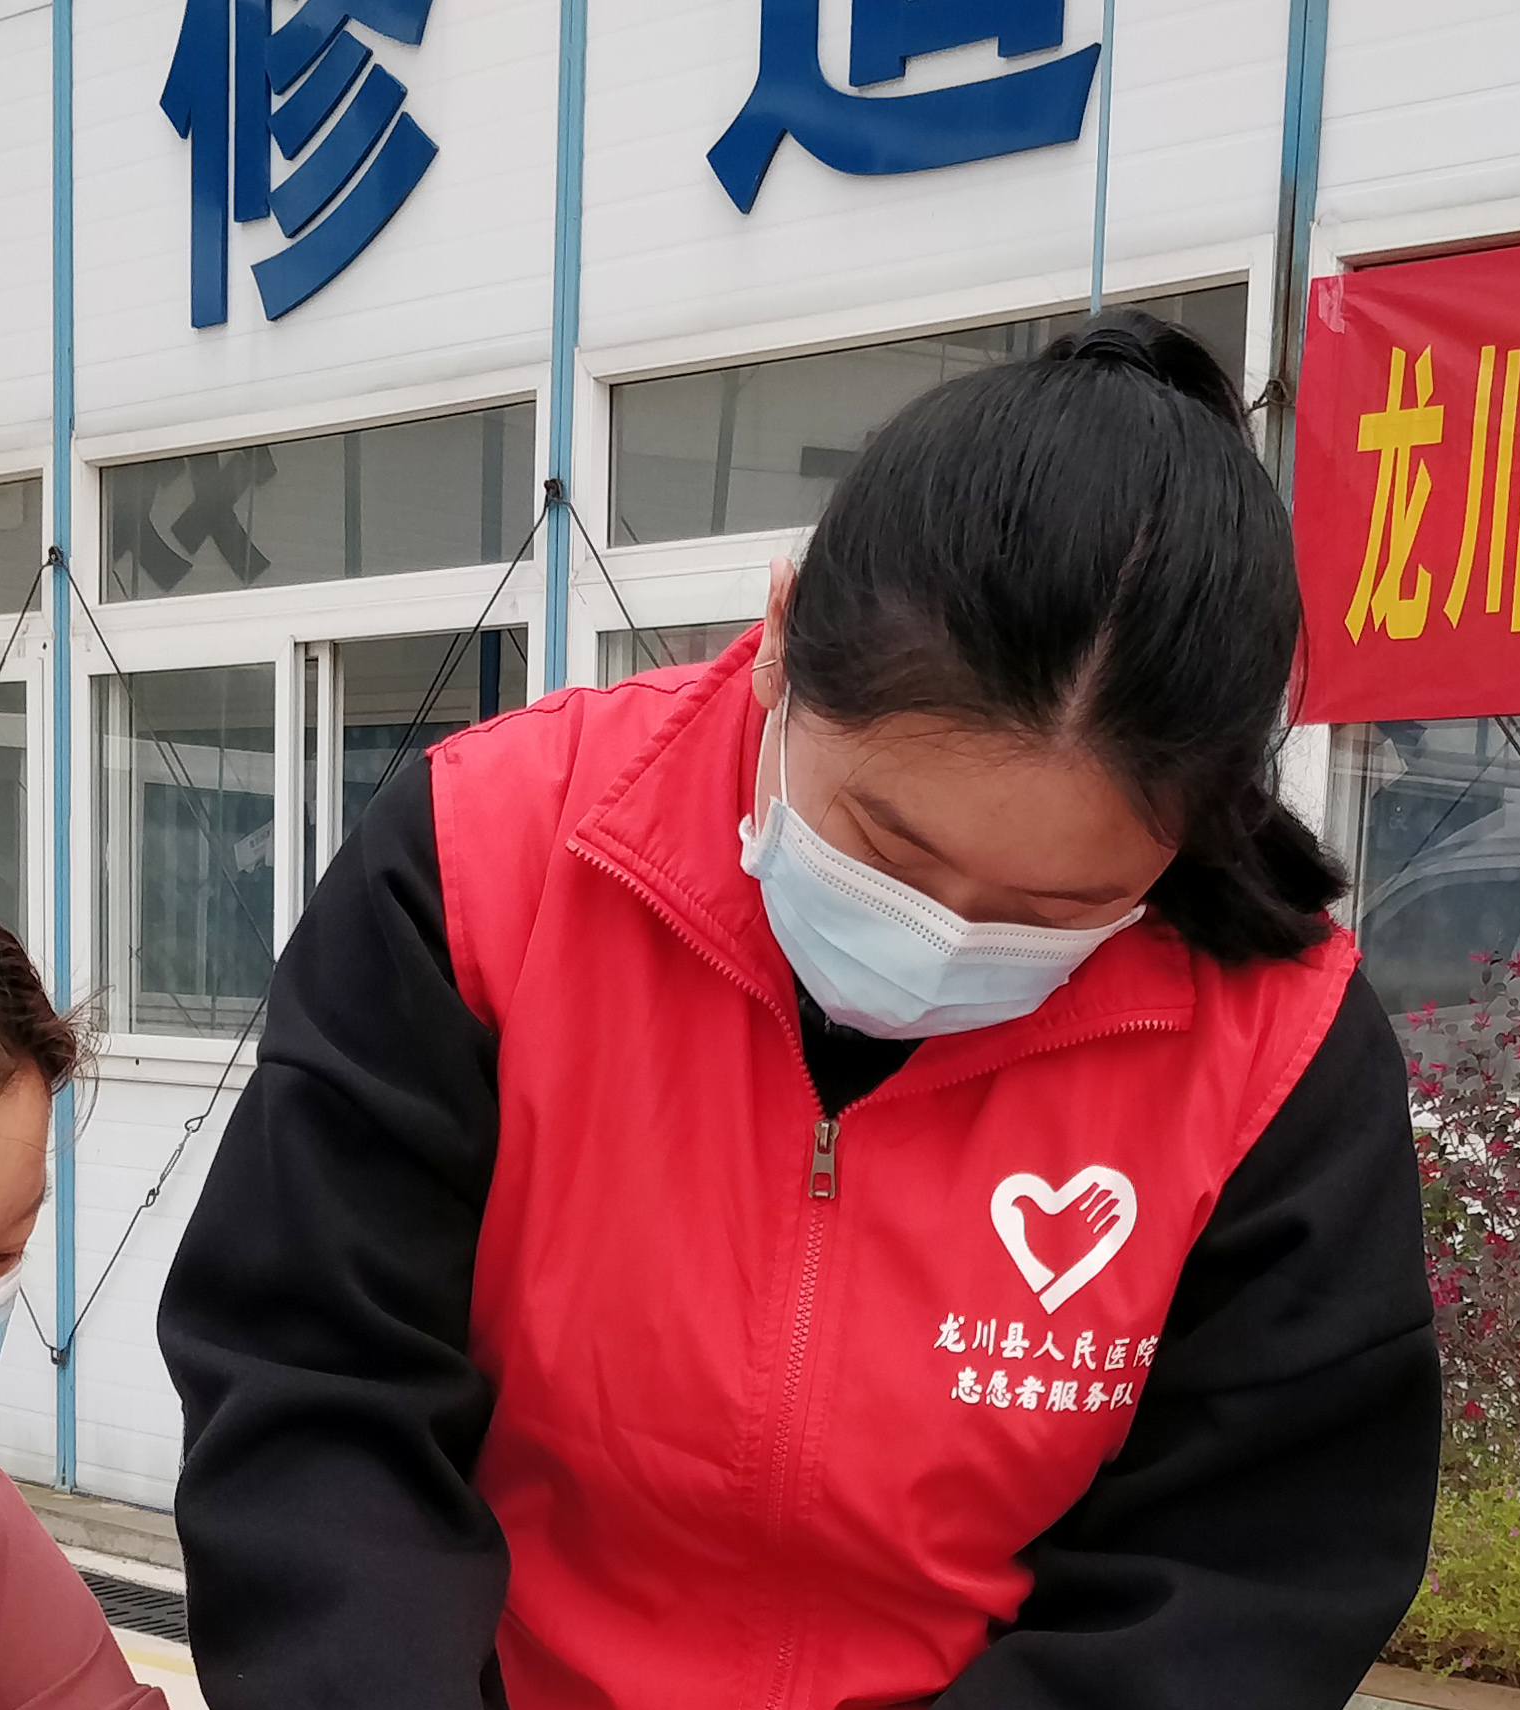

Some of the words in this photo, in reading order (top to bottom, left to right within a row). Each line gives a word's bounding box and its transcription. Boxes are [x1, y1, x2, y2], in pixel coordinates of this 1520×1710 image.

[933, 1312, 1163, 1372] 龙川县人民医院
[950, 1366, 1138, 1413] 志愿者服务队
